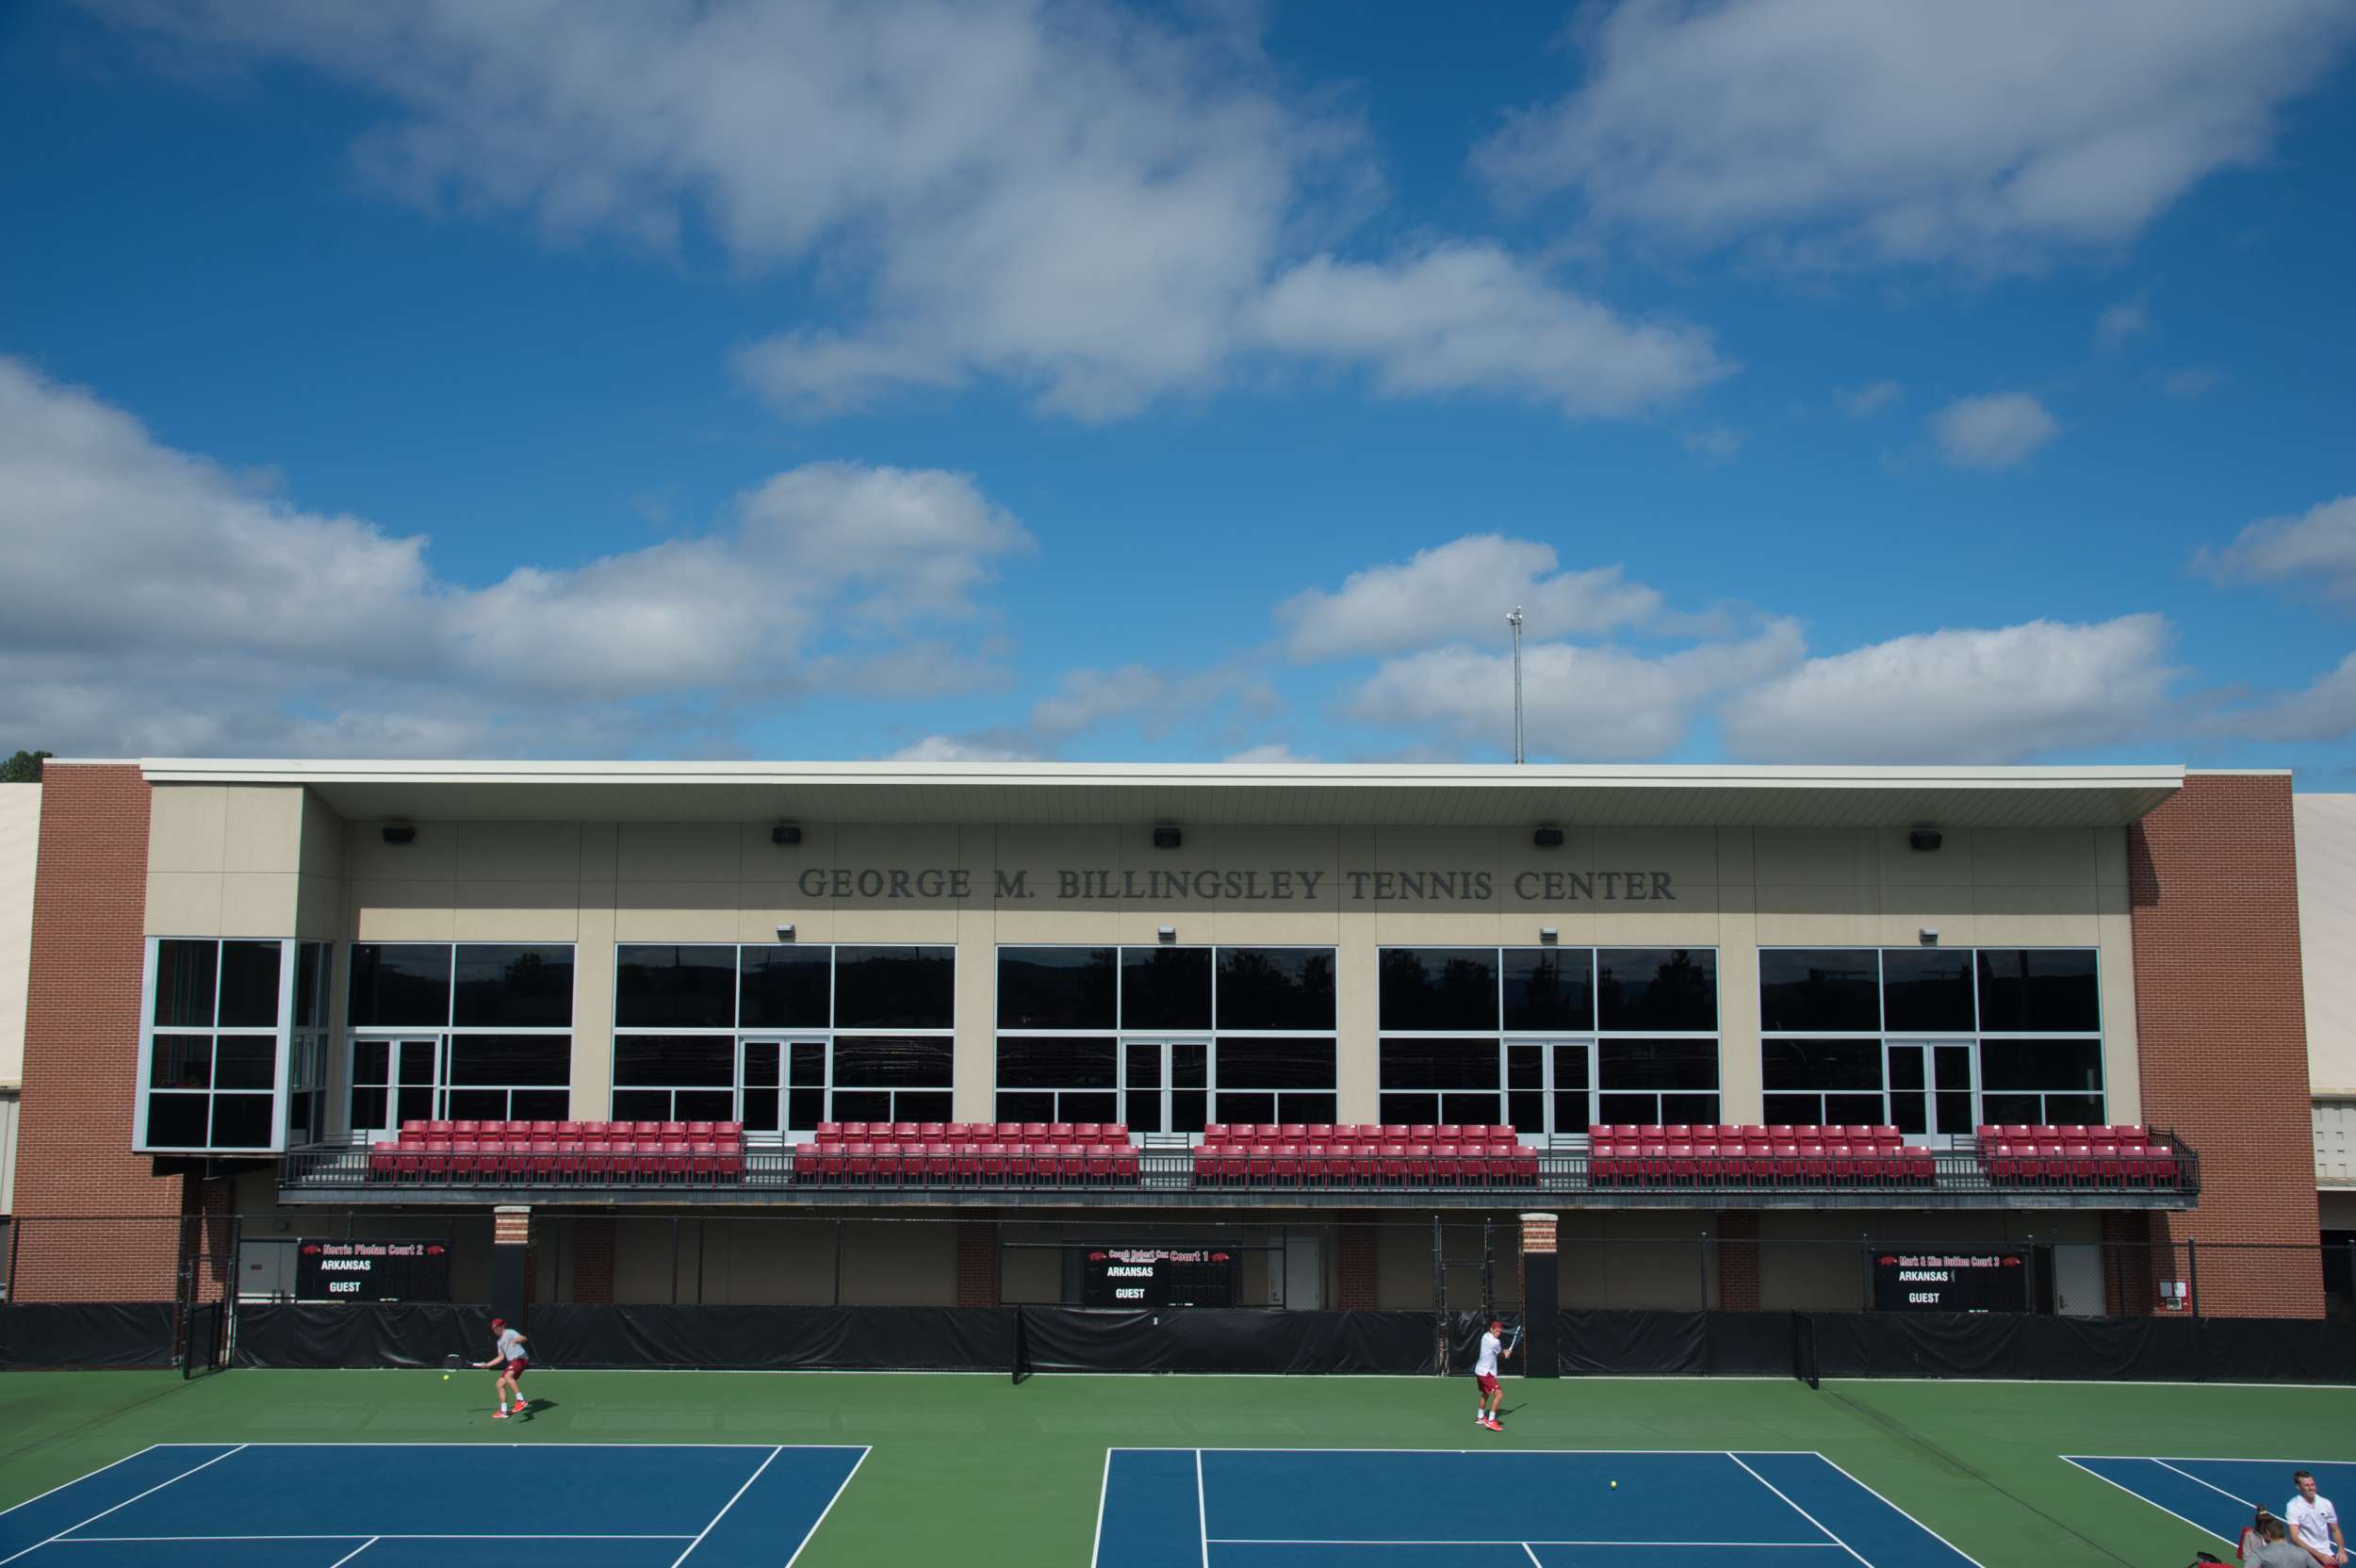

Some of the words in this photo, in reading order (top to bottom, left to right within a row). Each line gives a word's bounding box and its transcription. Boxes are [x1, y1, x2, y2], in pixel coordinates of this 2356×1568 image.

[797, 868, 973, 898] GEORGE
[993, 870, 1035, 898] M.
[1056, 870, 1324, 899] BILLINGSLEY
[1347, 871, 1493, 900] TENNIS
[1514, 871, 1677, 900] CENTER
[322, 1244, 352, 1255] Norris
[388, 1244, 415, 1255] Court
[417, 1245, 423, 1255] 2
[1170, 1250, 1201, 1262] Court
[1203, 1251, 1209, 1262] 1
[1899, 1256, 1919, 1266] Mark
[1971, 1256, 1993, 1266] Court
[1994, 1256, 2000, 1266] 3
[320, 1260, 371, 1270] ARKANSAS
[1107, 1266, 1153, 1277] ARKANSAS
[1899, 1271, 1948, 1282] ARKANSAS
[330, 1282, 361, 1293] GUEST
[1116, 1288, 1145, 1298] GUEST
[1909, 1293, 1939, 1303] GUEST
